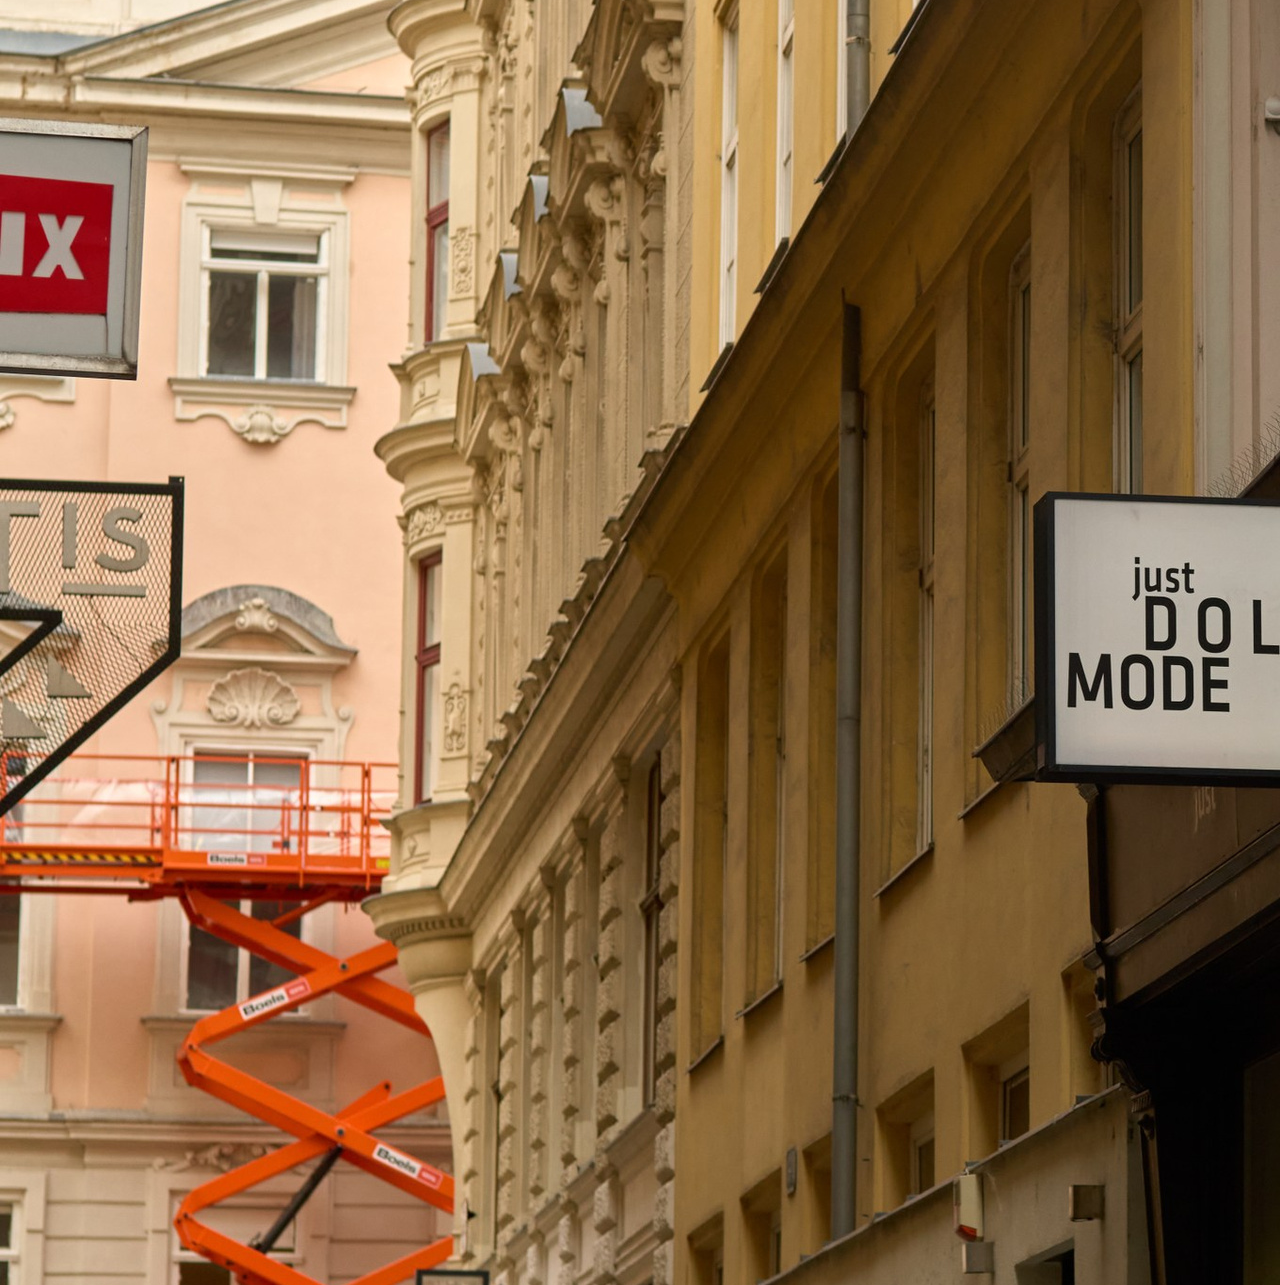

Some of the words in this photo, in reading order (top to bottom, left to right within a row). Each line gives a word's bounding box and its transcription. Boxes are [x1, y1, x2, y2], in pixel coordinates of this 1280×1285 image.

[1132, 557, 1194, 601] just
[1067, 652, 1230, 712] MODE
[243, 994, 285, 1016] Boels
[377, 1147, 417, 1174] Boels
